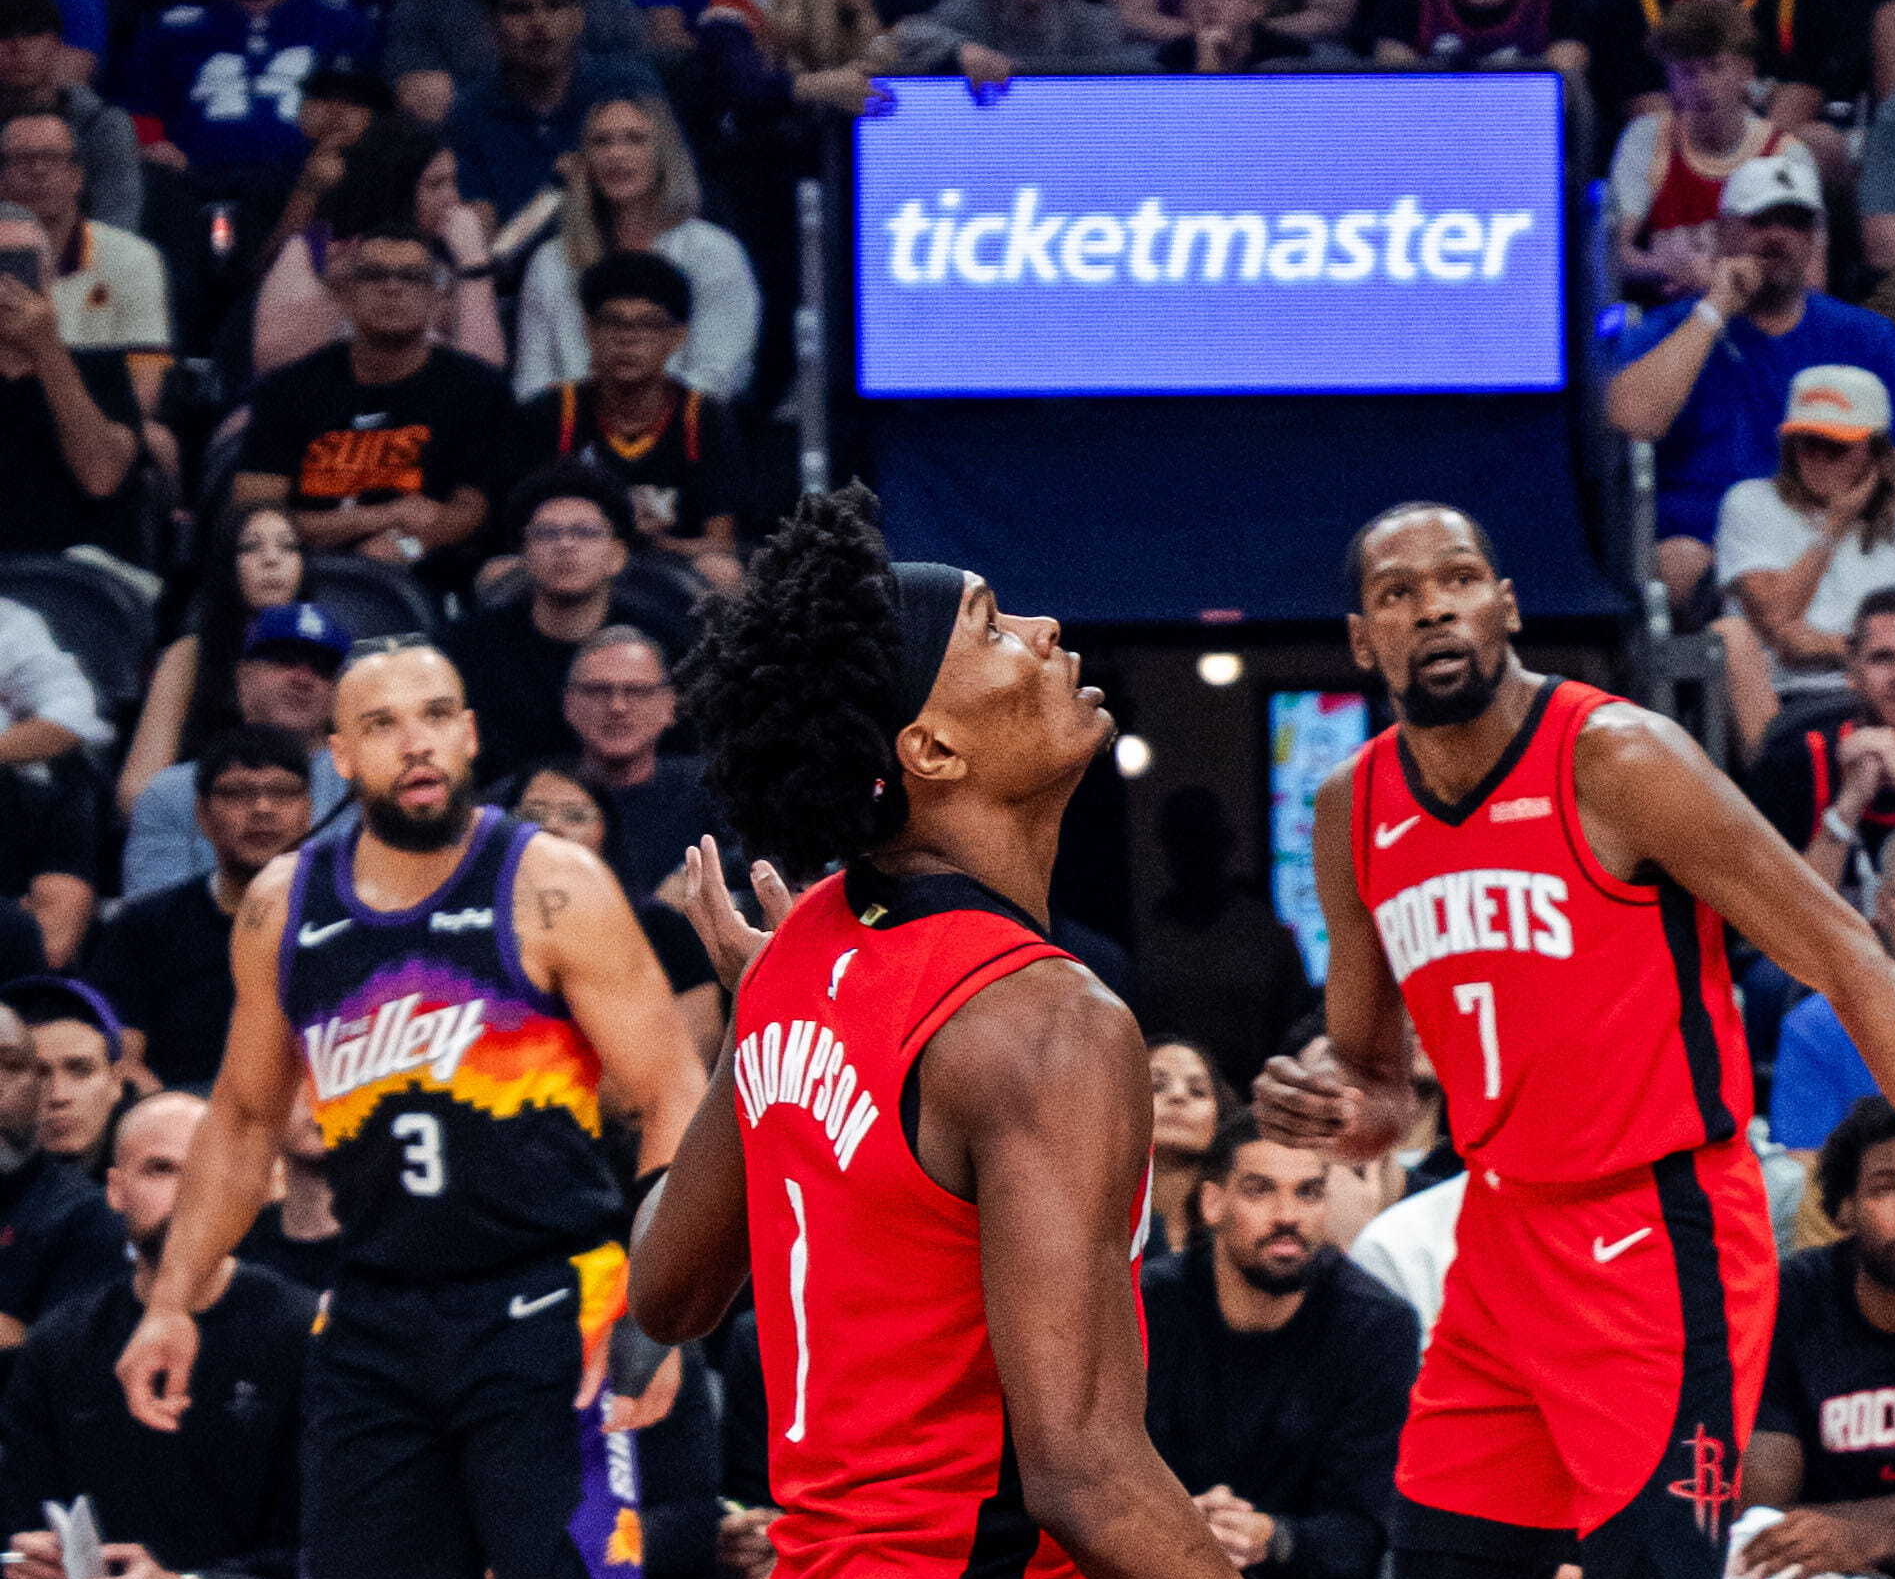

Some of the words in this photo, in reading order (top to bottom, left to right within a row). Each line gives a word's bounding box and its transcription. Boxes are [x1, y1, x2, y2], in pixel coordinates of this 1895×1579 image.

[886, 187, 1536, 285] ticketmaster
[1373, 867, 1575, 985] ROCKETS
[304, 992, 487, 1101] Valley
[734, 1019, 880, 1173] THOMPSON
[1452, 981, 1503, 1101] 7
[389, 1111, 446, 1198] 3
